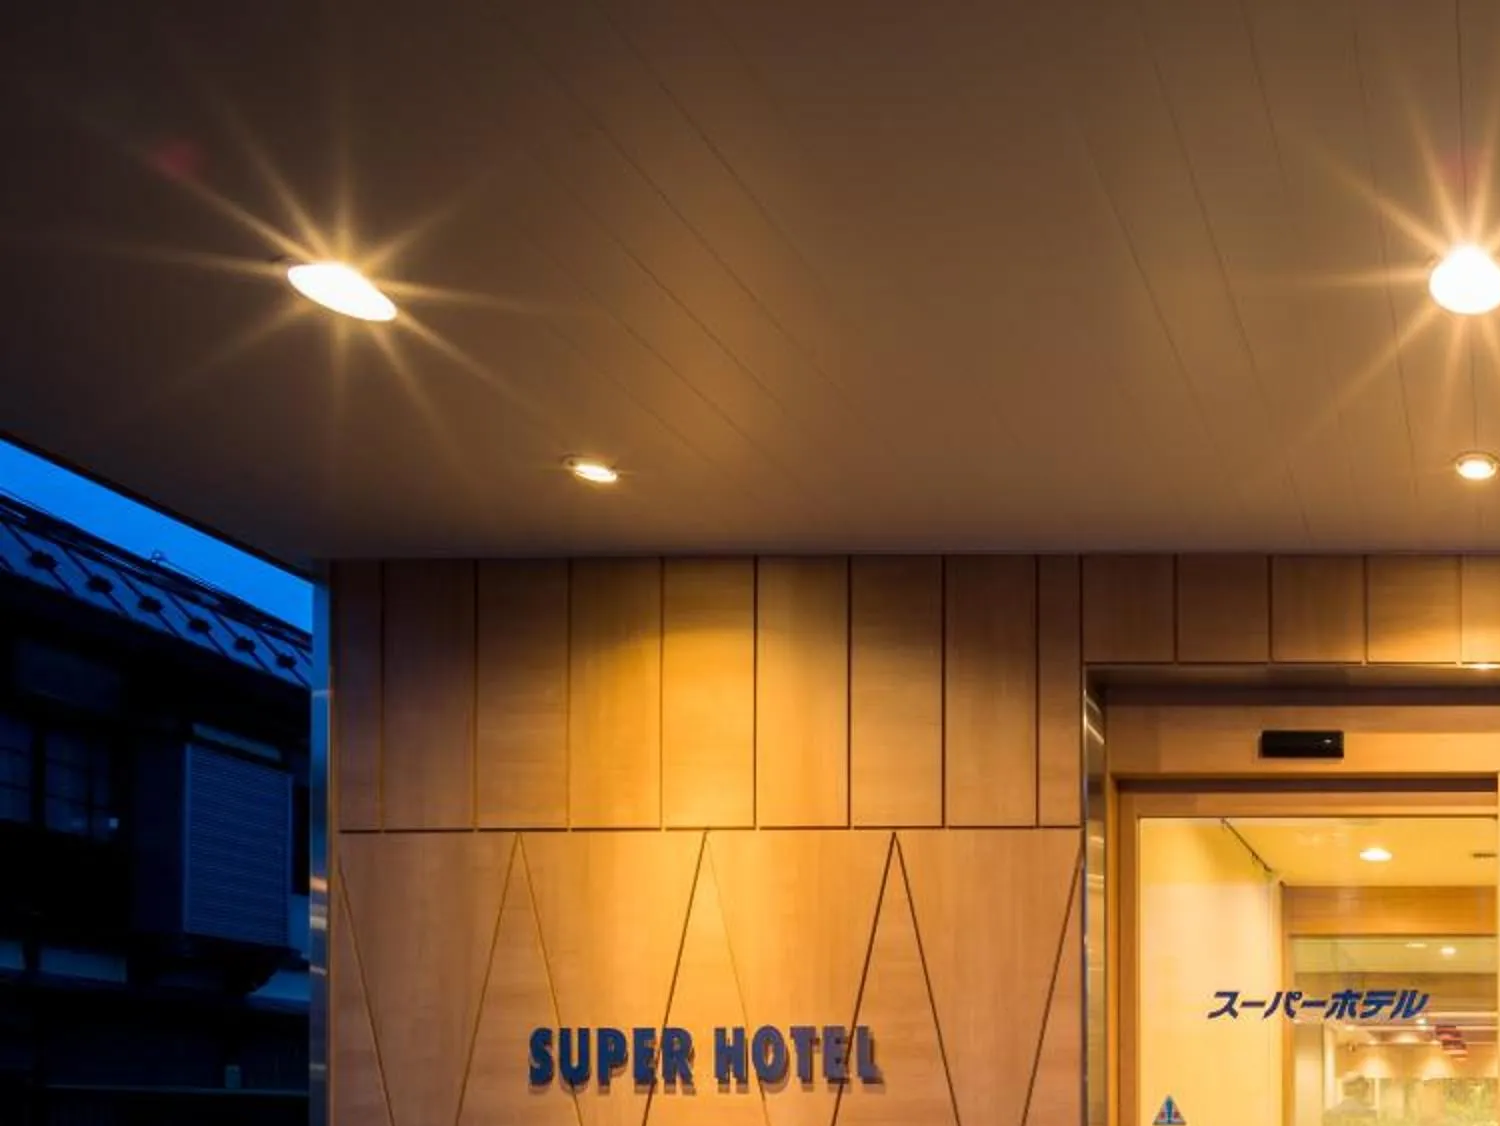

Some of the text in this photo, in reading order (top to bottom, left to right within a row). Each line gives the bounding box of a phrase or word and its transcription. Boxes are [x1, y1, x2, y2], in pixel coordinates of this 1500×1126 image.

[1207, 989, 1430, 1020] スーパーホテル
[529, 1024, 883, 1088] SUPER HOTEL
